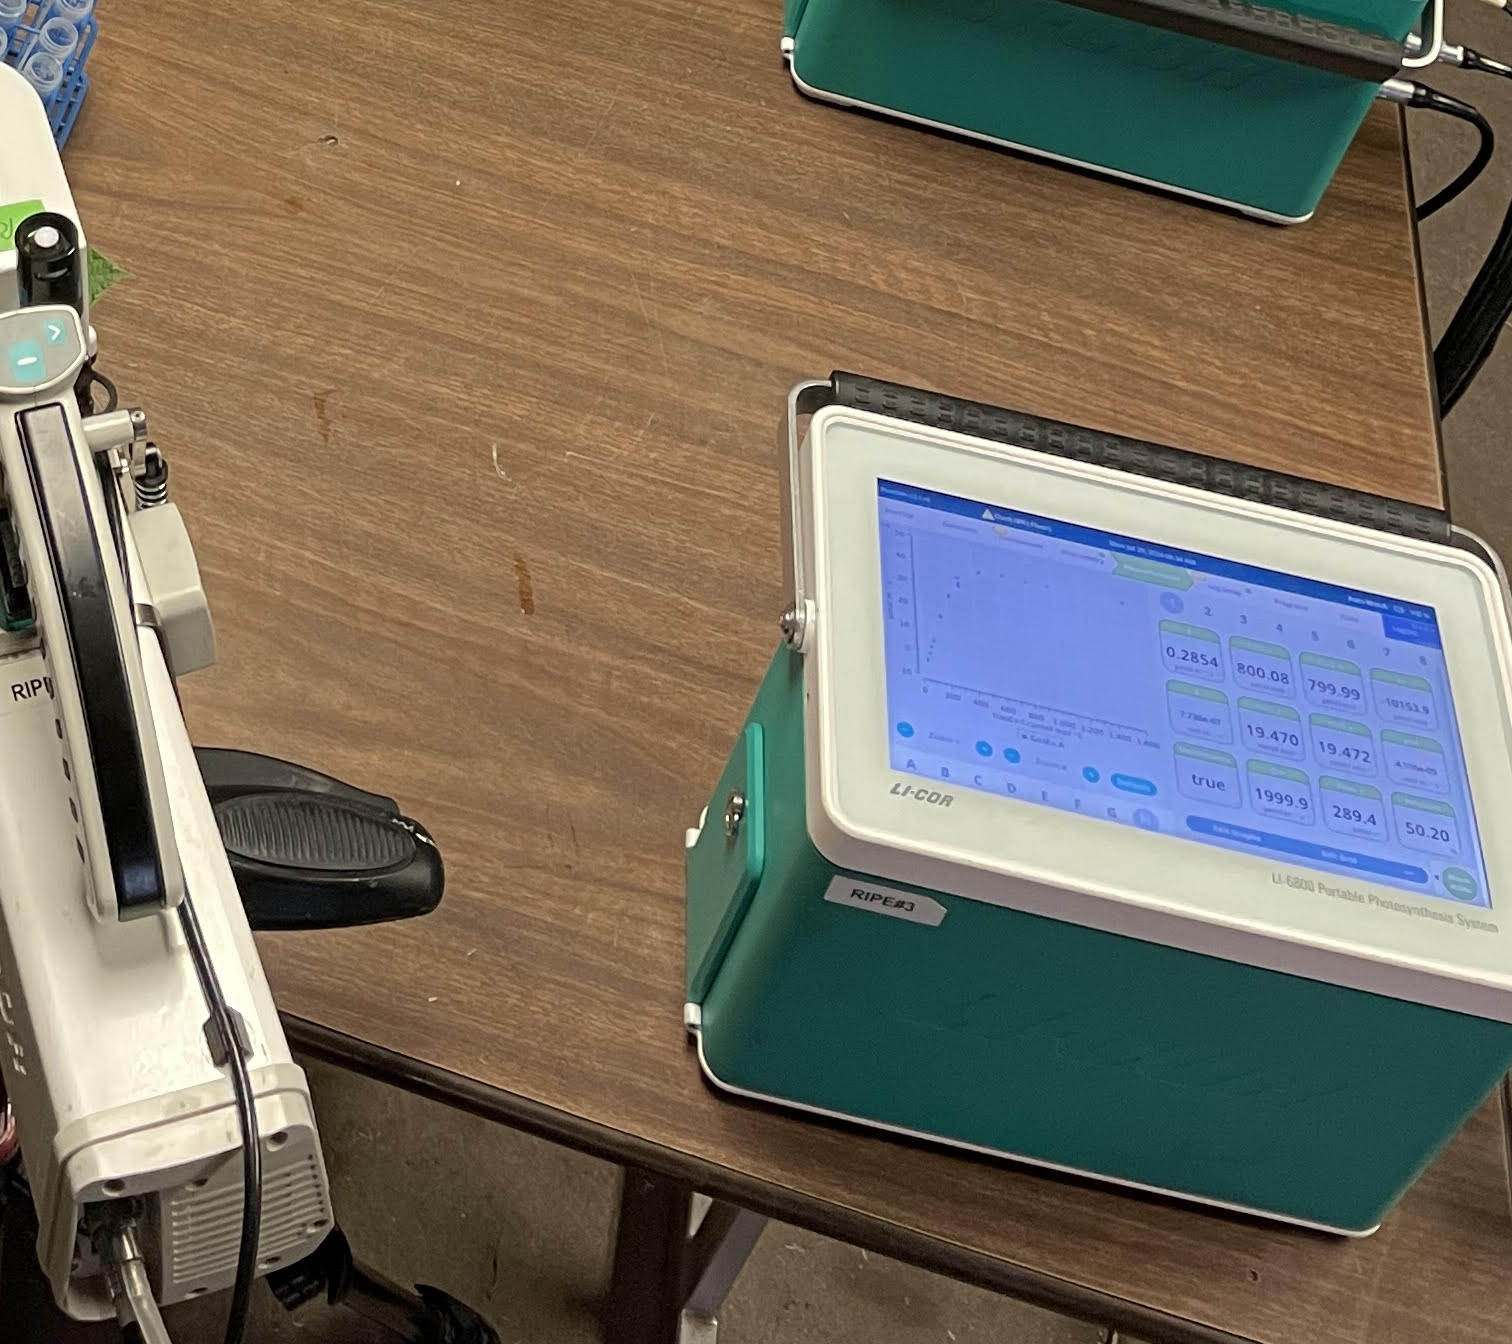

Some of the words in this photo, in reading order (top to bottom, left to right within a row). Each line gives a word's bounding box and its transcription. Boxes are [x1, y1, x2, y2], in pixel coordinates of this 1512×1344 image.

[1204, 606, 1212, 617] 2
[1239, 614, 1247, 625] 3
[1275, 623, 1284, 634] 4
[1311, 631, 1319, 642] 5
[1347, 639, 1355, 650] 6
[1383, 647, 1391, 658] 7
[1166, 647, 1219, 669] 0.2854
[1237, 663, 1290, 686] 800.08
[1307, 679, 1361, 702] 799.99
[1246, 724, 1299, 747] 19.470
[1318, 741, 1371, 764] 19.472
[890, 782, 954, 808] LI-COR
[906, 759, 917, 770] A
[941, 767, 950, 778] B
[974, 775, 983, 787] C
[1007, 783, 1016, 794] D
[1041, 791, 1048, 802] E
[1107, 807, 1117, 819] G
[1191, 773, 1226, 792] true
[1255, 788, 1309, 811] 1999.9
[1332, 805, 1377, 827] 289.4
[1405, 821, 1450, 843] 50.20
[850, 888, 916, 912] RIPE#3
[1272, 872, 1315, 893] LI-6800
[1317, 881, 1366, 904] Portable
[1368, 894, 1454, 924] Photosynthesis
[1456, 913, 1499, 933] System
